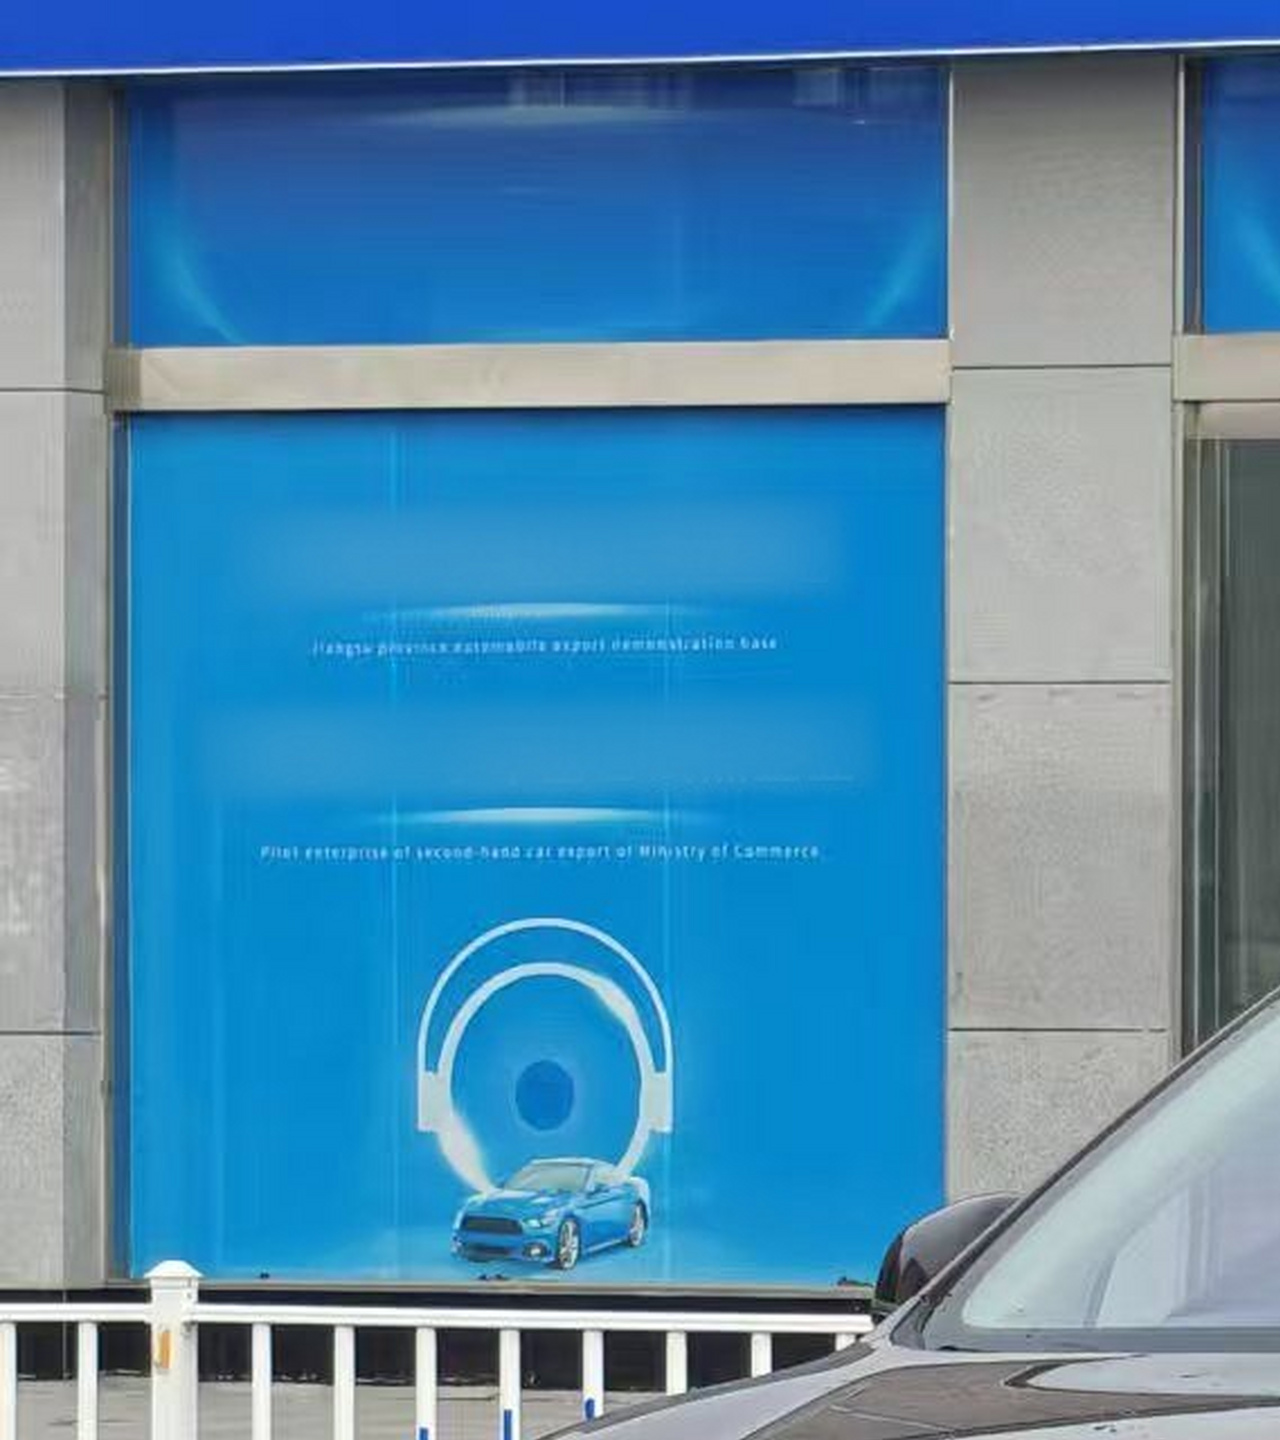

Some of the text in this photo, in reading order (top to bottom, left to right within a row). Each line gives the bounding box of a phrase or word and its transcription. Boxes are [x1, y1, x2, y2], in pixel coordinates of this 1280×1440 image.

[552, 639, 605, 653] export
[612, 636, 735, 652] demonstration
[740, 636, 778, 650] base
[259, 845, 299, 860] Pilot
[305, 845, 388, 861] enterprise
[394, 845, 411, 860] of
[416, 845, 521, 860] second-hand
[526, 846, 550, 859] car
[557, 846, 611, 861] export
[616, 845, 632, 859] of
[639, 845, 706, 862] Ministry
[711, 845, 729, 859] of
